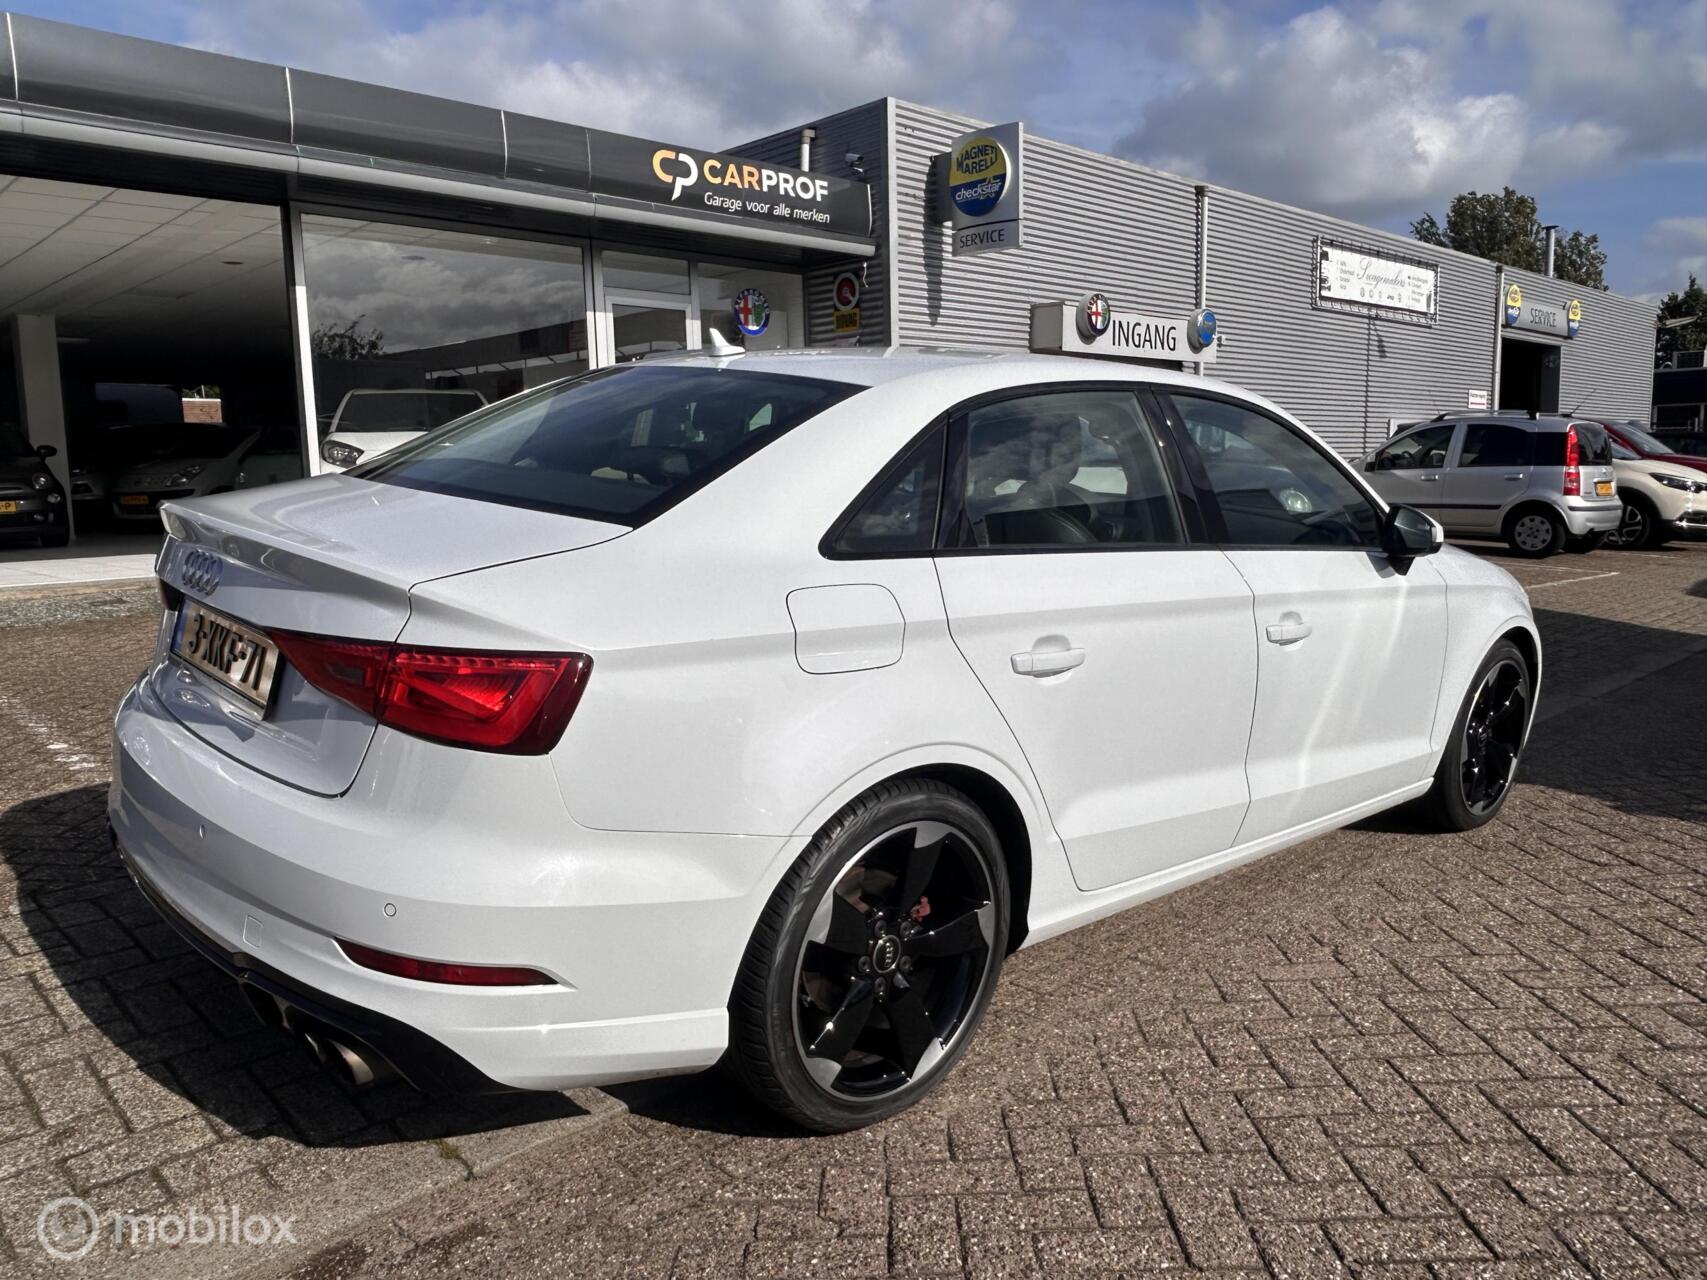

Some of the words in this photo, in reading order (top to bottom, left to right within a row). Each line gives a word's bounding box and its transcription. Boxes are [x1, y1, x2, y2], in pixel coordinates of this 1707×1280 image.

[703, 159, 829, 201] CARPROF
[704, 192, 742, 212] Garage
[746, 200, 770, 213] voor
[773, 203, 790, 216] alle
[793, 208, 830, 224] merken
[960, 229, 1005, 248] SERVICE
[1530, 308, 1557, 328] SERVICE
[1112, 319, 1177, 351] INGANG
